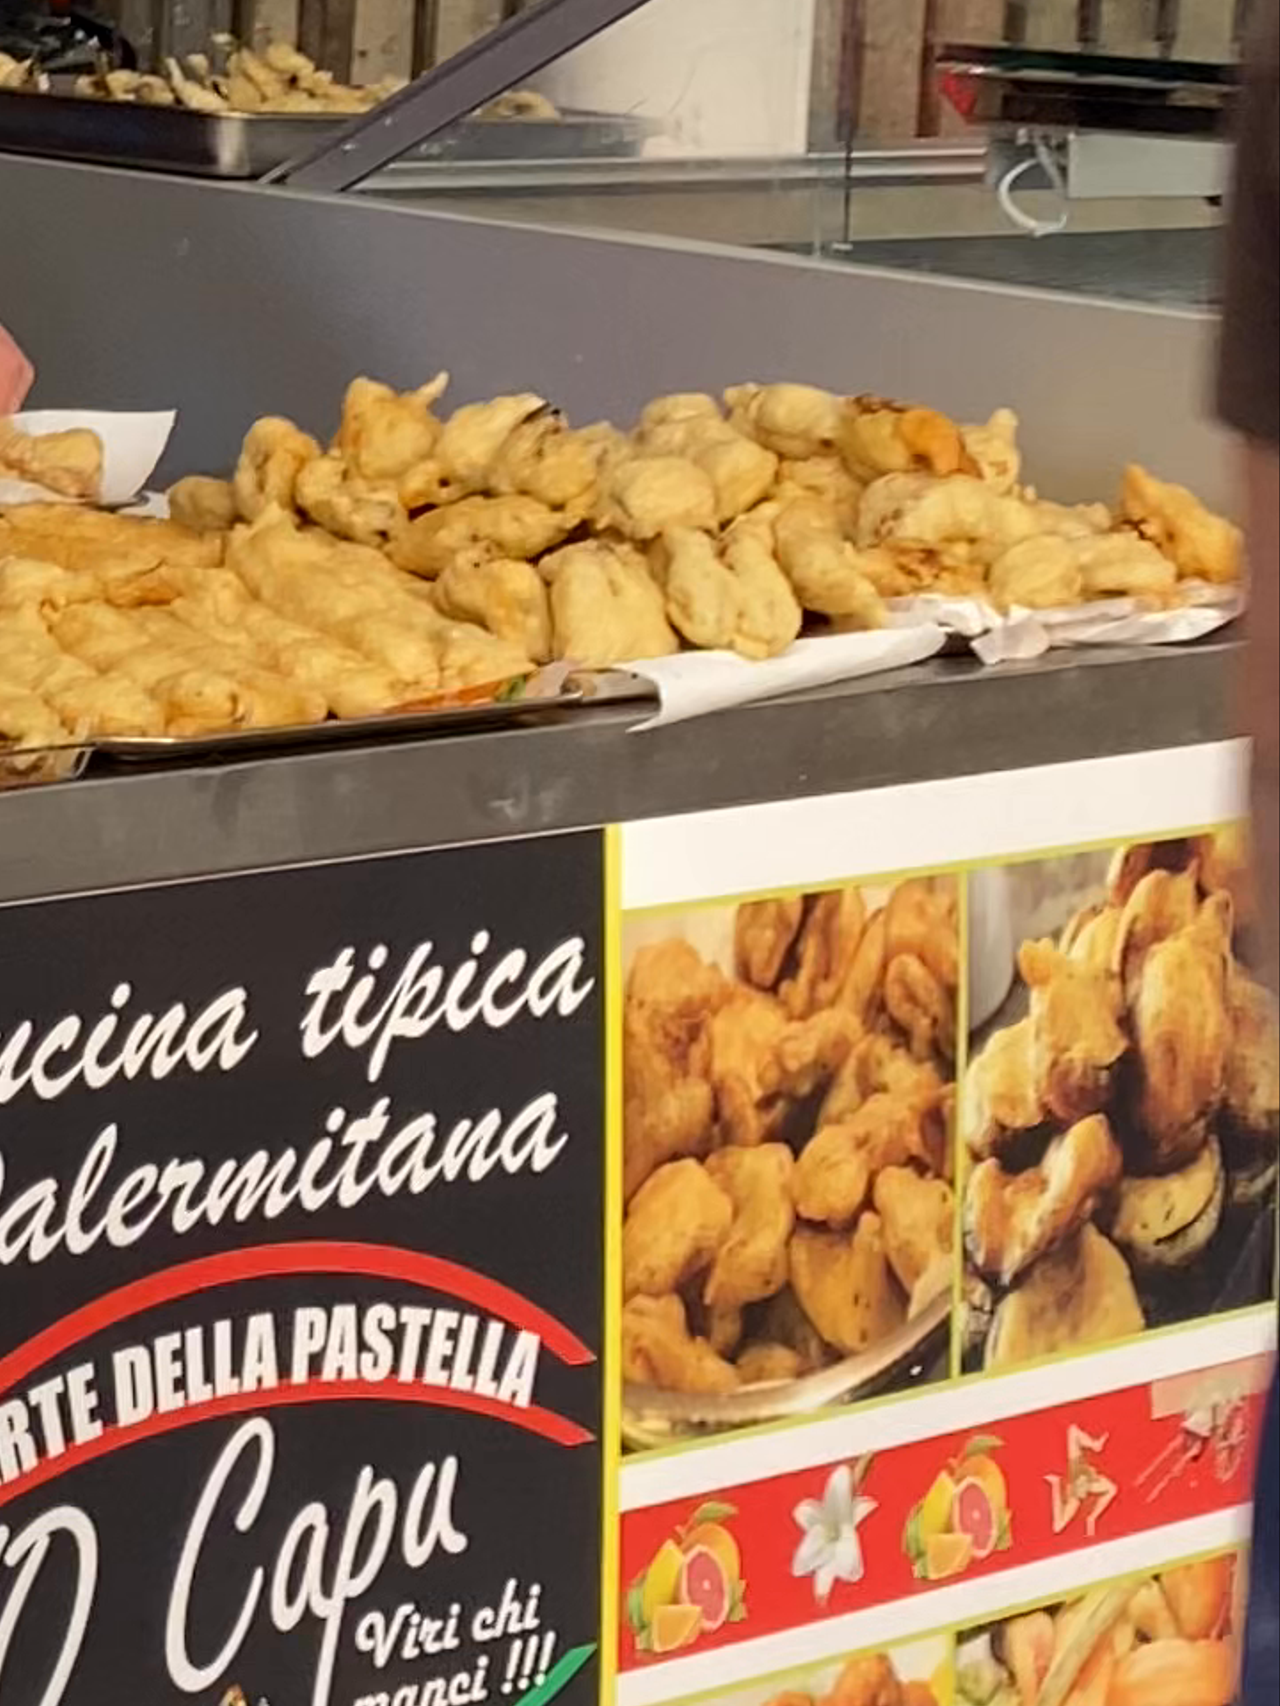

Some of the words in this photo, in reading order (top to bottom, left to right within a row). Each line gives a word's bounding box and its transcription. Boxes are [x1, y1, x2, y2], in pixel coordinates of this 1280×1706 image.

[299, 929, 596, 1083] tipica
[110, 1311, 278, 1429] DELLA
[291, 1303, 541, 1408] PASTELLA
[354, 1601, 463, 1668] Viri
[470, 1577, 542, 1642] chi
[500, 1631, 557, 1695] !!!
